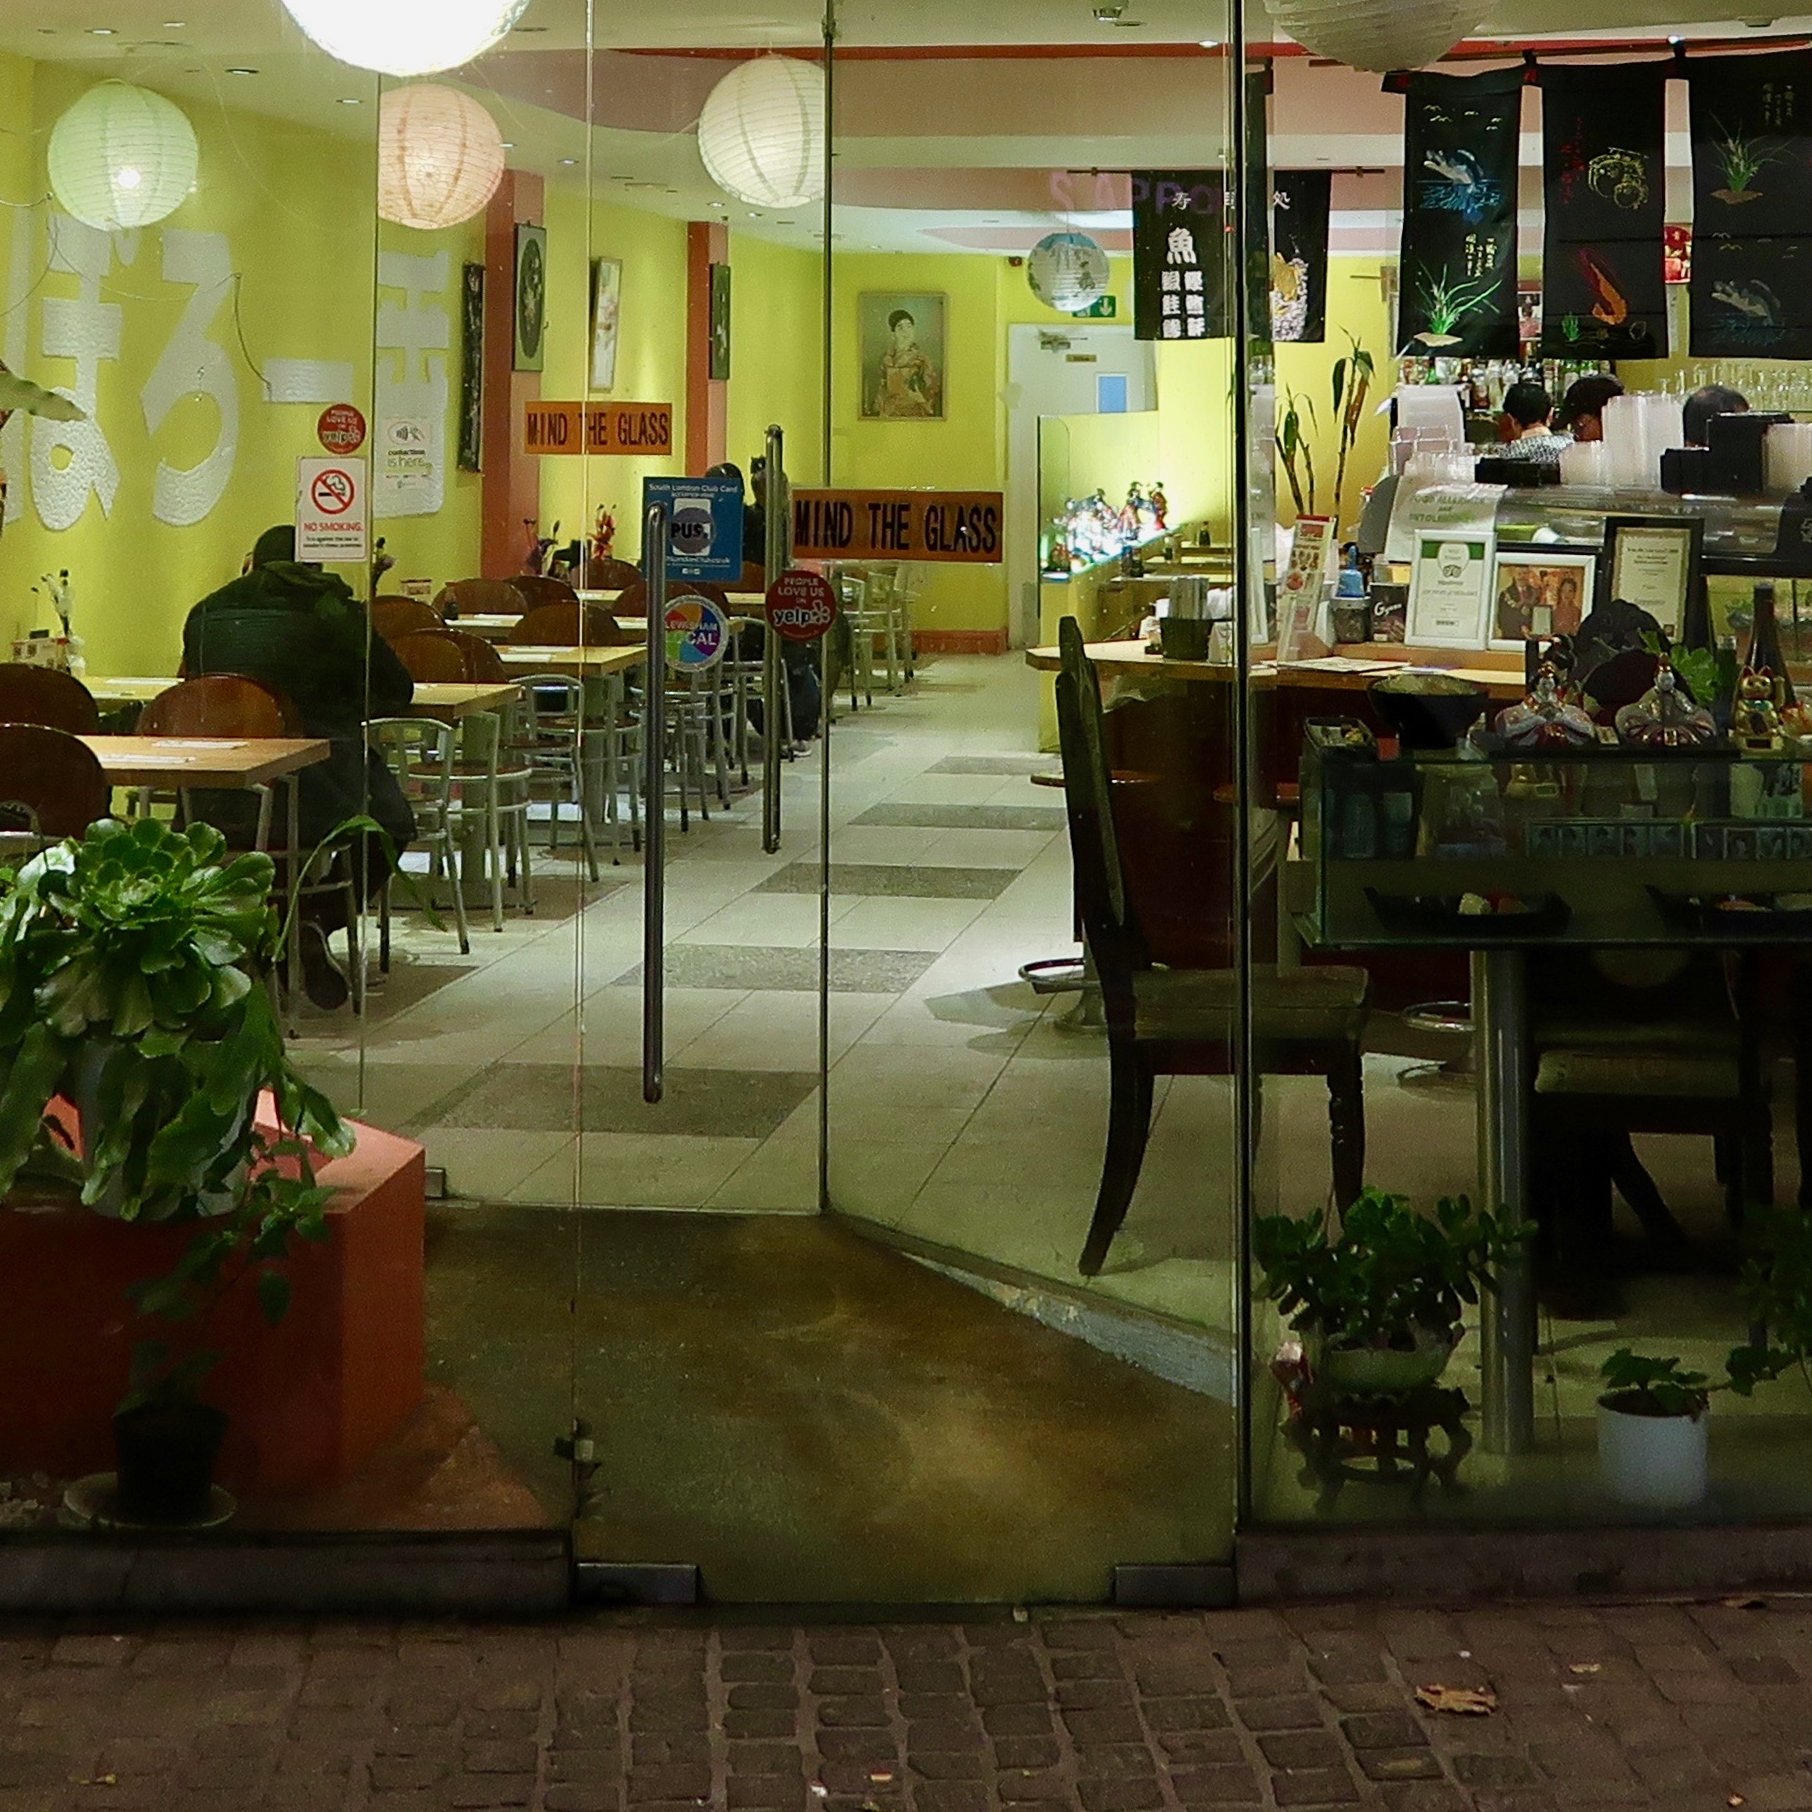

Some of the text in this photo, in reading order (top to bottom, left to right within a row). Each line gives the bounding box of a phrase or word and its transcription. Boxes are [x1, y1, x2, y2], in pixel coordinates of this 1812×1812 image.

[527, 412, 669, 446] MIND THE GLASS
[303, 522, 317, 532] NO
[670, 522, 709, 539] PUS
[795, 499, 998, 552] MIND THE GLASS
[784, 577, 819, 587] PEOPLE
[778, 587, 825, 597] LOVE US
[773, 608, 813, 628] yelp
